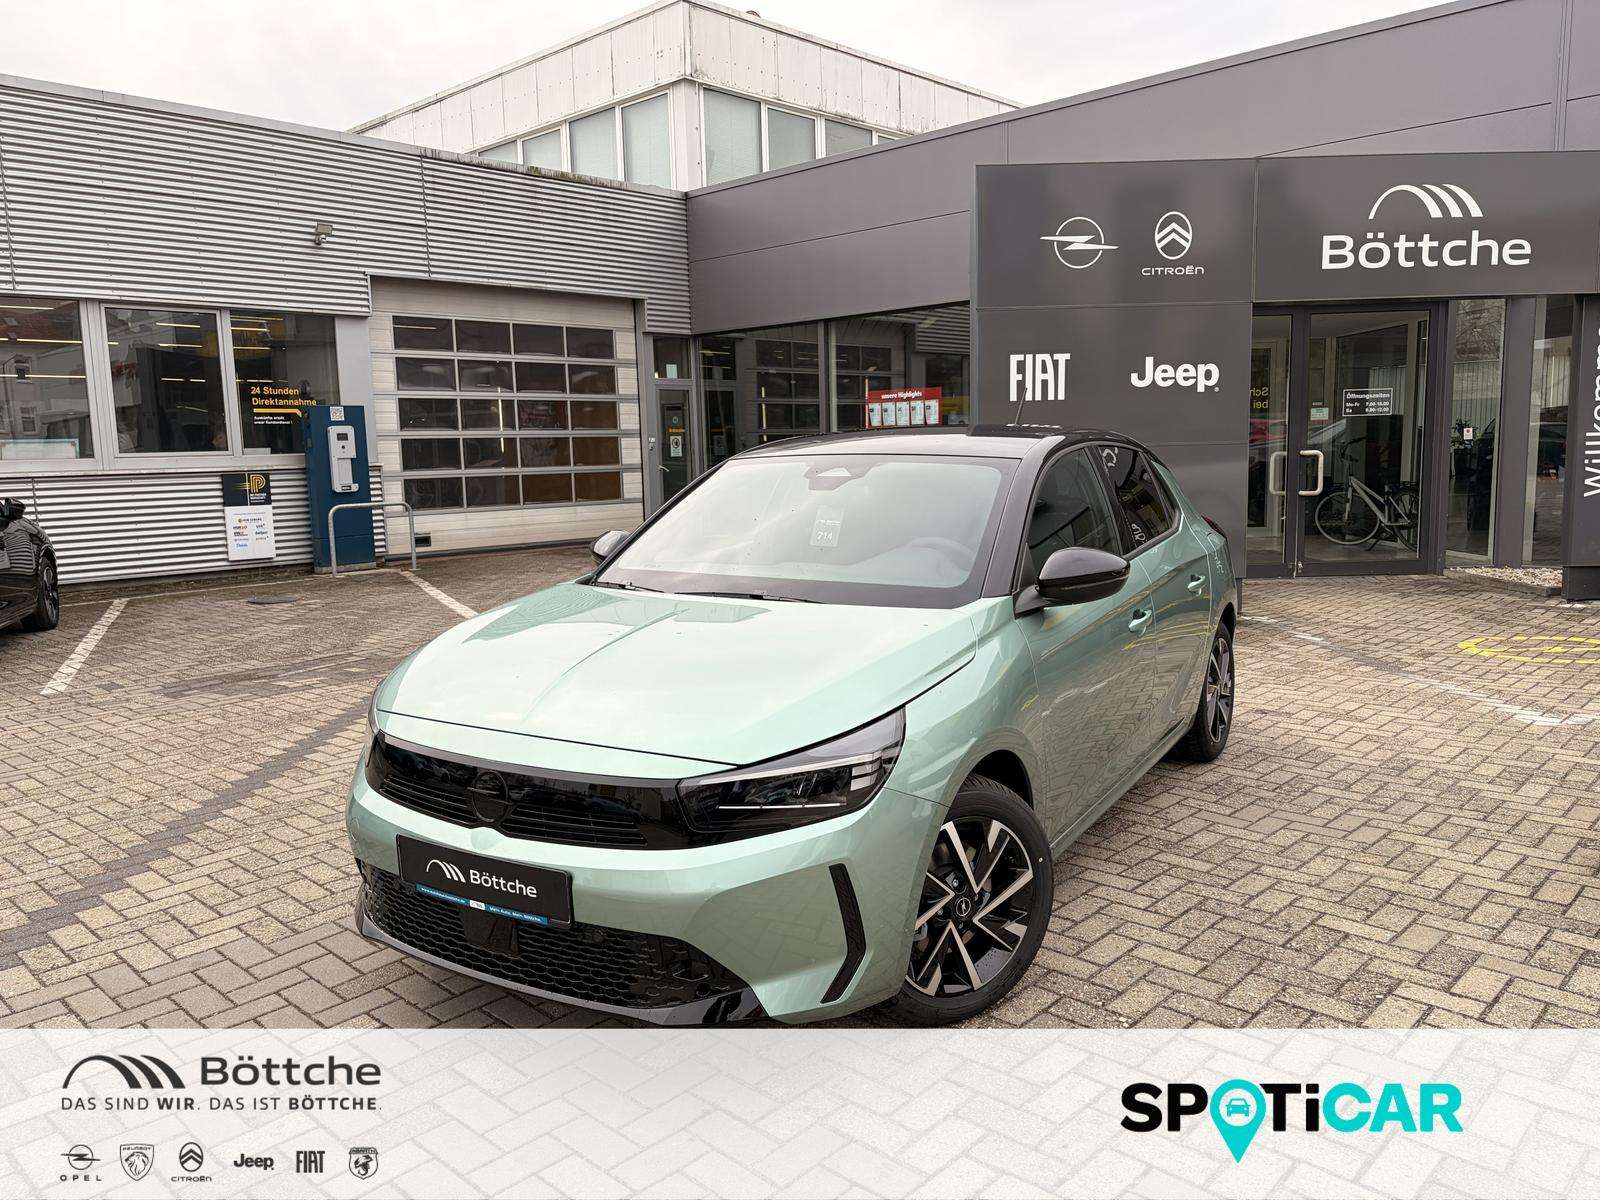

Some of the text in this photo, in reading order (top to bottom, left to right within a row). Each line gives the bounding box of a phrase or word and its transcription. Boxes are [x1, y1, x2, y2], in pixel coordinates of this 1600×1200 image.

[1321, 230, 1532, 270] Böttche
[1142, 265, 1204, 276] CITROËN
[1010, 353, 1071, 402] FIAT
[1131, 356, 1220, 392] Jeep
[250, 386, 300, 396] 24 Stunden
[898, 390, 923, 399] Highlights
[1346, 391, 1391, 399] Öffnungszeiten
[252, 397, 317, 406] Direktannahme
[469, 869, 538, 898] Böttche
